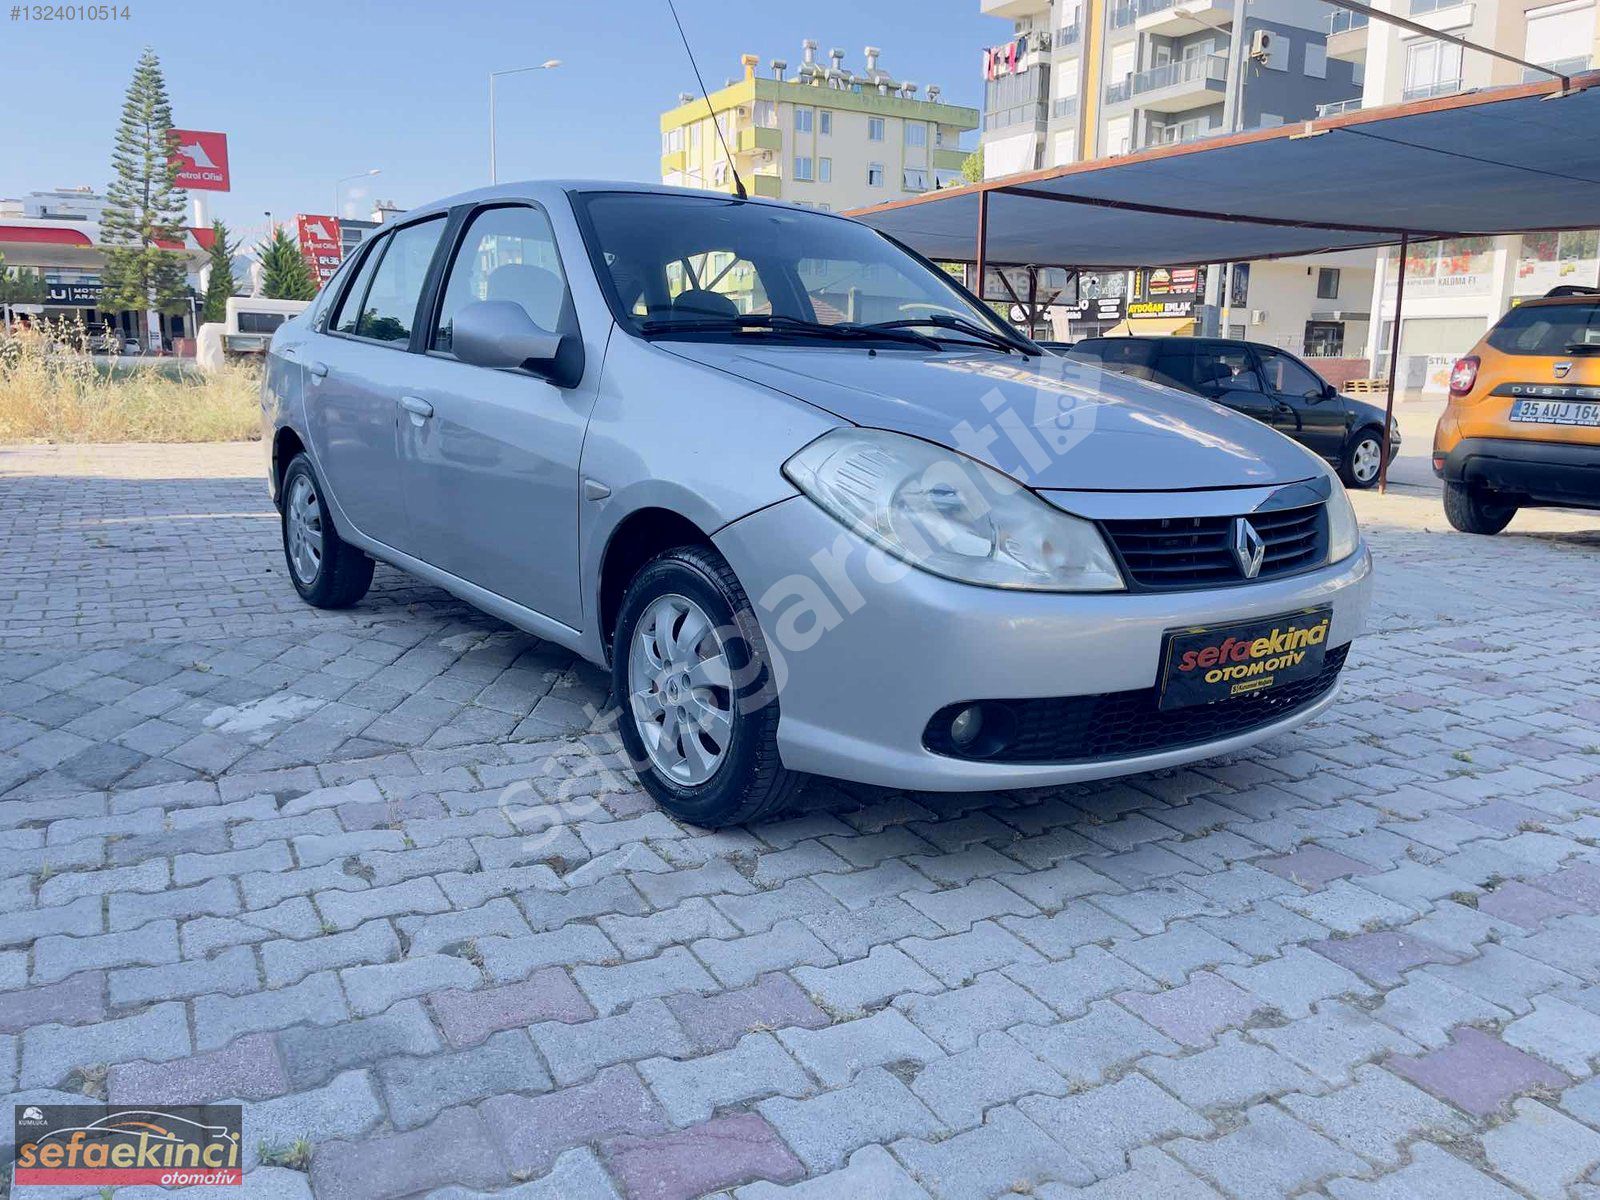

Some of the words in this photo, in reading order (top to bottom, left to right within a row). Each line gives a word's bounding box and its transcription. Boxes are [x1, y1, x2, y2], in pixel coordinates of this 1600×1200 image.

[1511, 386, 1600, 397] DUSTER
[1521, 402, 1540, 416] 35
[1542, 404, 1569, 417] AUJ
[1575, 405, 1599, 420] 164
